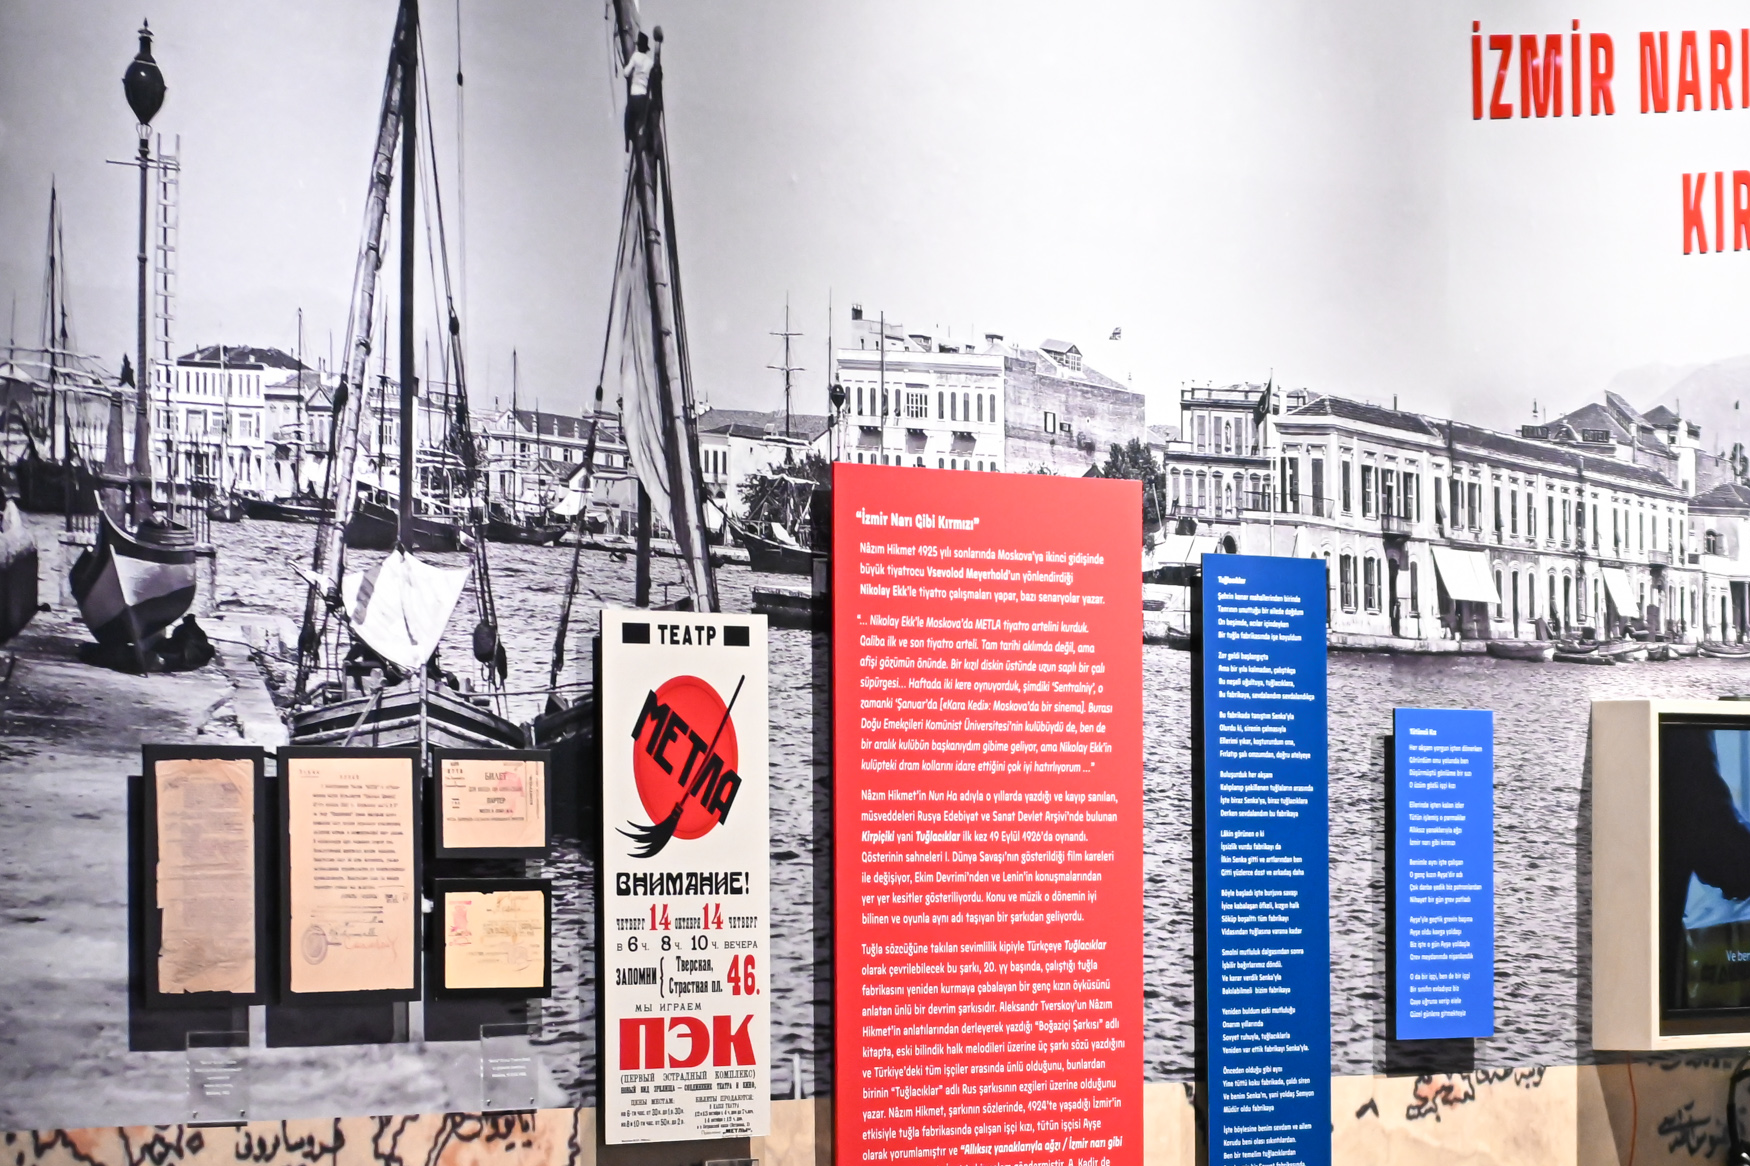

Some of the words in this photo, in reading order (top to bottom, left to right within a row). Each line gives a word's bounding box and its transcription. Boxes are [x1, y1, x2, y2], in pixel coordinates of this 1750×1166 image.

[1471, 18, 1616, 120] İZMİR
[1638, 28, 1750, 114] NARI
[891, 511, 913, 527] Narı
[915, 513, 935, 529] Gibi
[860, 542, 884, 553] Nâzım
[887, 543, 916, 555] Hikmet
[918, 545, 938, 556] 1925
[939, 546, 951, 559] yılı
[953, 547, 995, 559] sonlarında
[1045, 550, 1066, 563] ikinci
[1068, 552, 1104, 566] gidişinde
[860, 562, 884, 576] büyük
[887, 564, 924, 577] tiyatrocu
[926, 566, 964, 578] Vsevolod
[1022, 570, 1073, 585] yönlendirdiği
[860, 583, 890, 598] Nikolay
[918, 586, 946, 599] tiyatro
[948, 587, 992, 601] çalışmaları
[993, 592, 1018, 602] yapar,
[1020, 589, 1036, 601] bazı
[1038, 591, 1080, 605] senaryolar
[1081, 595, 1105, 606] yazar.
[658, 624, 717, 646] ТЕАТР
[860, 634, 885, 646] Galiba
[887, 635, 896, 646] ilk
[898, 638, 907, 647] ve
[910, 639, 924, 647] son
[926, 637, 954, 650] tiyatro
[956, 638, 978, 649] arteli.
[981, 638, 997, 650] Tam
[999, 639, 1020, 650] tarihi
[1022, 640, 1053, 652] aklımda
[1054, 640, 1075, 655] değil,
[1077, 644, 1095, 653] ama
[631, 689, 742, 825] МЕТЛА
[861, 810, 914, 821] müsveddeleri
[917, 810, 941, 823] Rusya
[943, 810, 978, 823] Edebiyat
[980, 813, 990, 821] ve
[992, 810, 1015, 821] Sanat
[1017, 810, 1042, 821] Devlet
[1086, 810, 1117, 821] bulunan
[616, 872, 749, 896] ВНИМАНИЕ!
[616, 918, 645, 931] ЧЕТВЕРГ
[649, 903, 671, 931] 14
[675, 917, 701, 929] ОКТЯБРЯ
[702, 903, 724, 930] 14
[728, 916, 758, 929] ЧЕТВЕРГ
[862, 913, 888, 924] bilinen
[891, 915, 900, 923] ve
[903, 912, 929, 925] oyunla
[932, 914, 948, 925] aynı
[951, 911, 963, 922] adı
[966, 912, 994, 924] taşıyan
[997, 911, 1008, 922] bir
[1010, 911, 1043, 924] şarkıdan
[1046, 910, 1084, 924] geliyordu.
[628, 936, 638, 952] 6
[661, 935, 671, 951] 8
[691, 935, 708, 951] 10
[724, 940, 758, 949] ВЕЧЕРА
[616, 967, 657, 985] ЗАПОМНИ
[676, 956, 714, 975] Тверская,
[669, 977, 708, 997] Страстная
[711, 980, 723, 993] пл.
[862, 984, 904, 995] fabrikasını
[906, 983, 938, 996] yeniden
[940, 982, 974, 995] kurmaya
[977, 981, 1016, 994] çabalayan
[1019, 980, 1030, 991] bir
[1032, 982, 1050, 993] genç
[1053, 980, 1070, 990] kızın
[1072, 978, 1110, 992] öyküsünü
[635, 1004, 652, 1012] МЫ
[660, 1002, 702, 1011] ИГРАЕМ
[619, 1014, 757, 1071] ПЭК
[620, 1073, 655, 1085] (ПЕРВЫЙ
[663, 1071, 707, 1081] ЭСТРАДНЫЙ
[715, 1069, 756, 1080] КОМПЛЕКС)
[862, 1127, 896, 1140] etkisiyle
[899, 1126, 919, 1140] tuğla
[922, 1124, 971, 1136] fabrikasında
[974, 1123, 1001, 1136] çalışan
[1004, 1122, 1017, 1134] işçi
[1020, 1121, 1034, 1132] kızı,
[1037, 1120, 1058, 1130] tütün
[1061, 1118, 1080, 1131] işçisi
[1083, 1118, 1101, 1130] Ayşe
